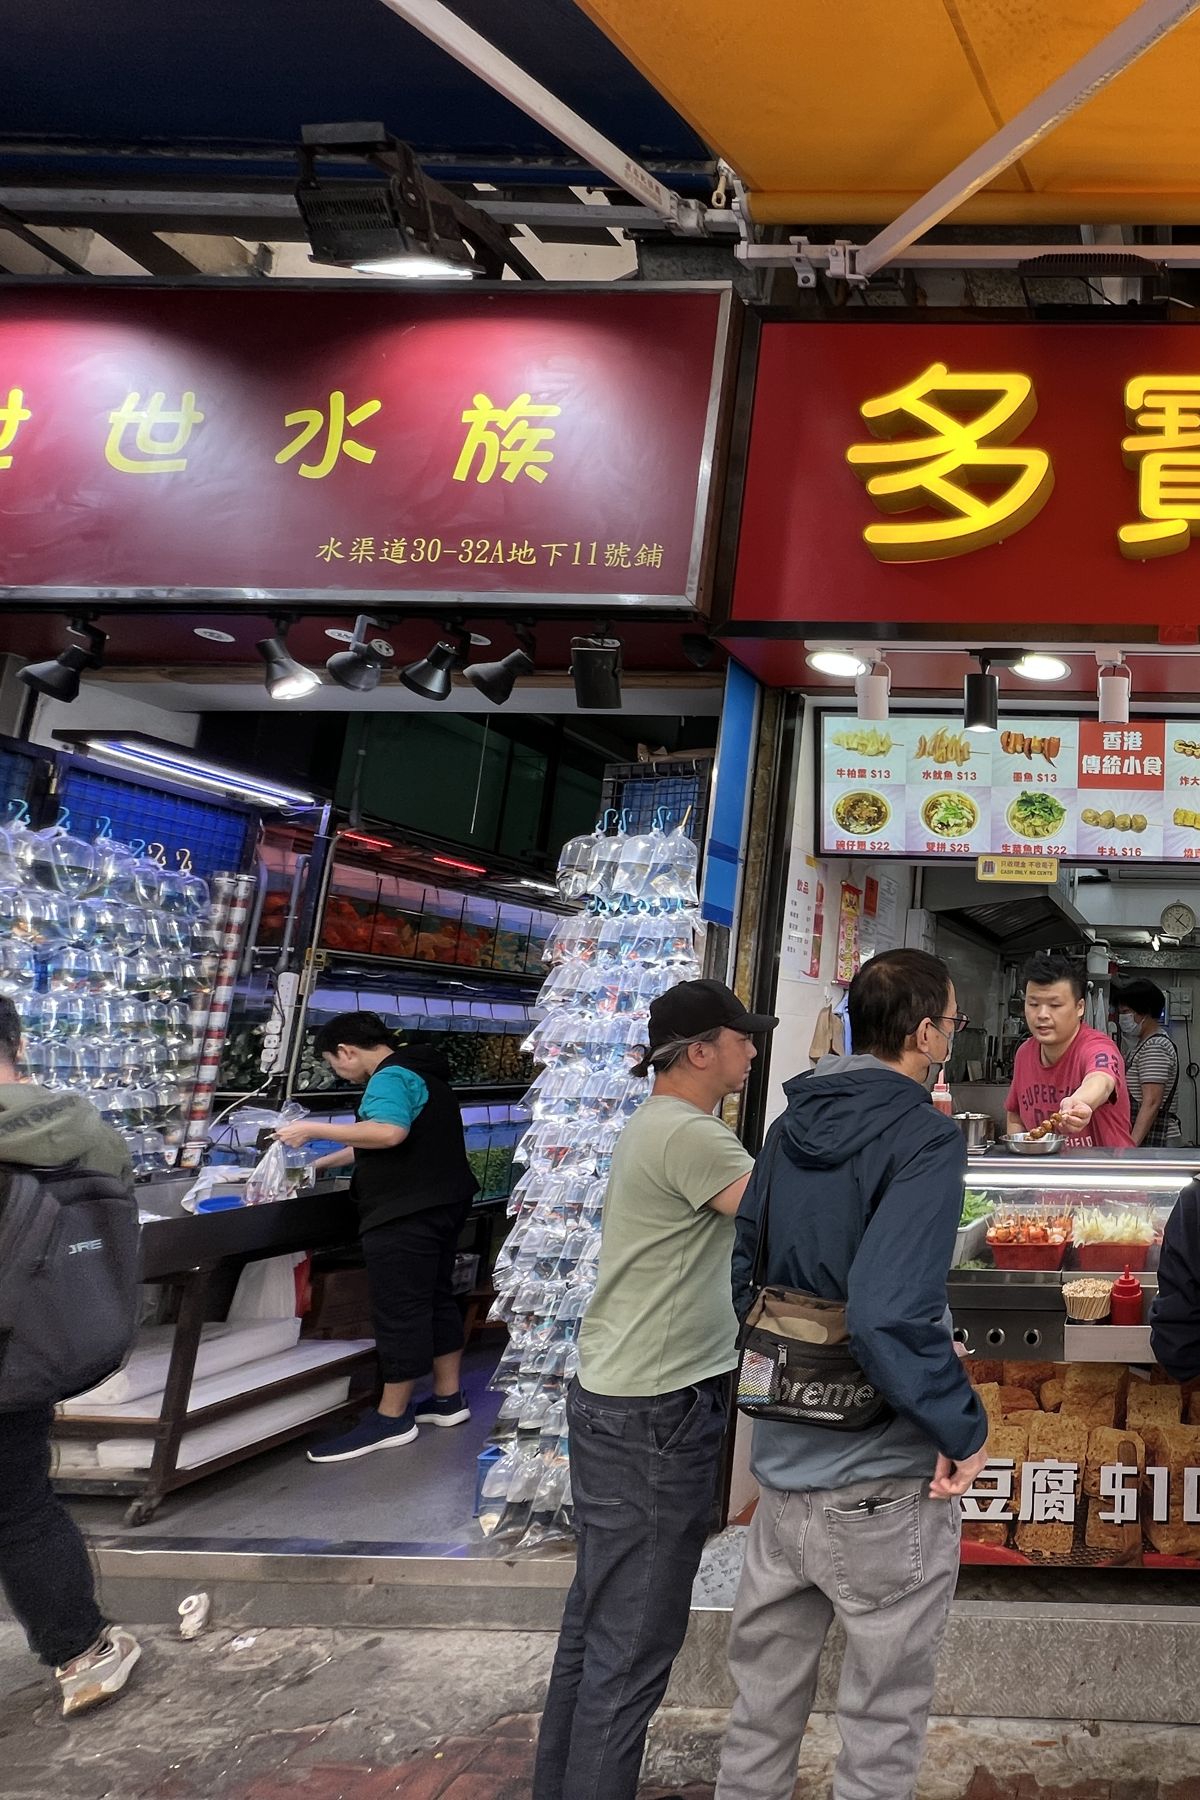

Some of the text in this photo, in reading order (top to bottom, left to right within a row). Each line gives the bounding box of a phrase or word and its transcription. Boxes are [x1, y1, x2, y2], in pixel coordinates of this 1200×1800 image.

[315, 537, 666, 568] 水渠道30-32A地下11號鋪
[1103, 731, 1142, 751] 香港
[1082, 755, 1162, 776] 傳統小食
[961, 1459, 1078, 1521] 豆腐
